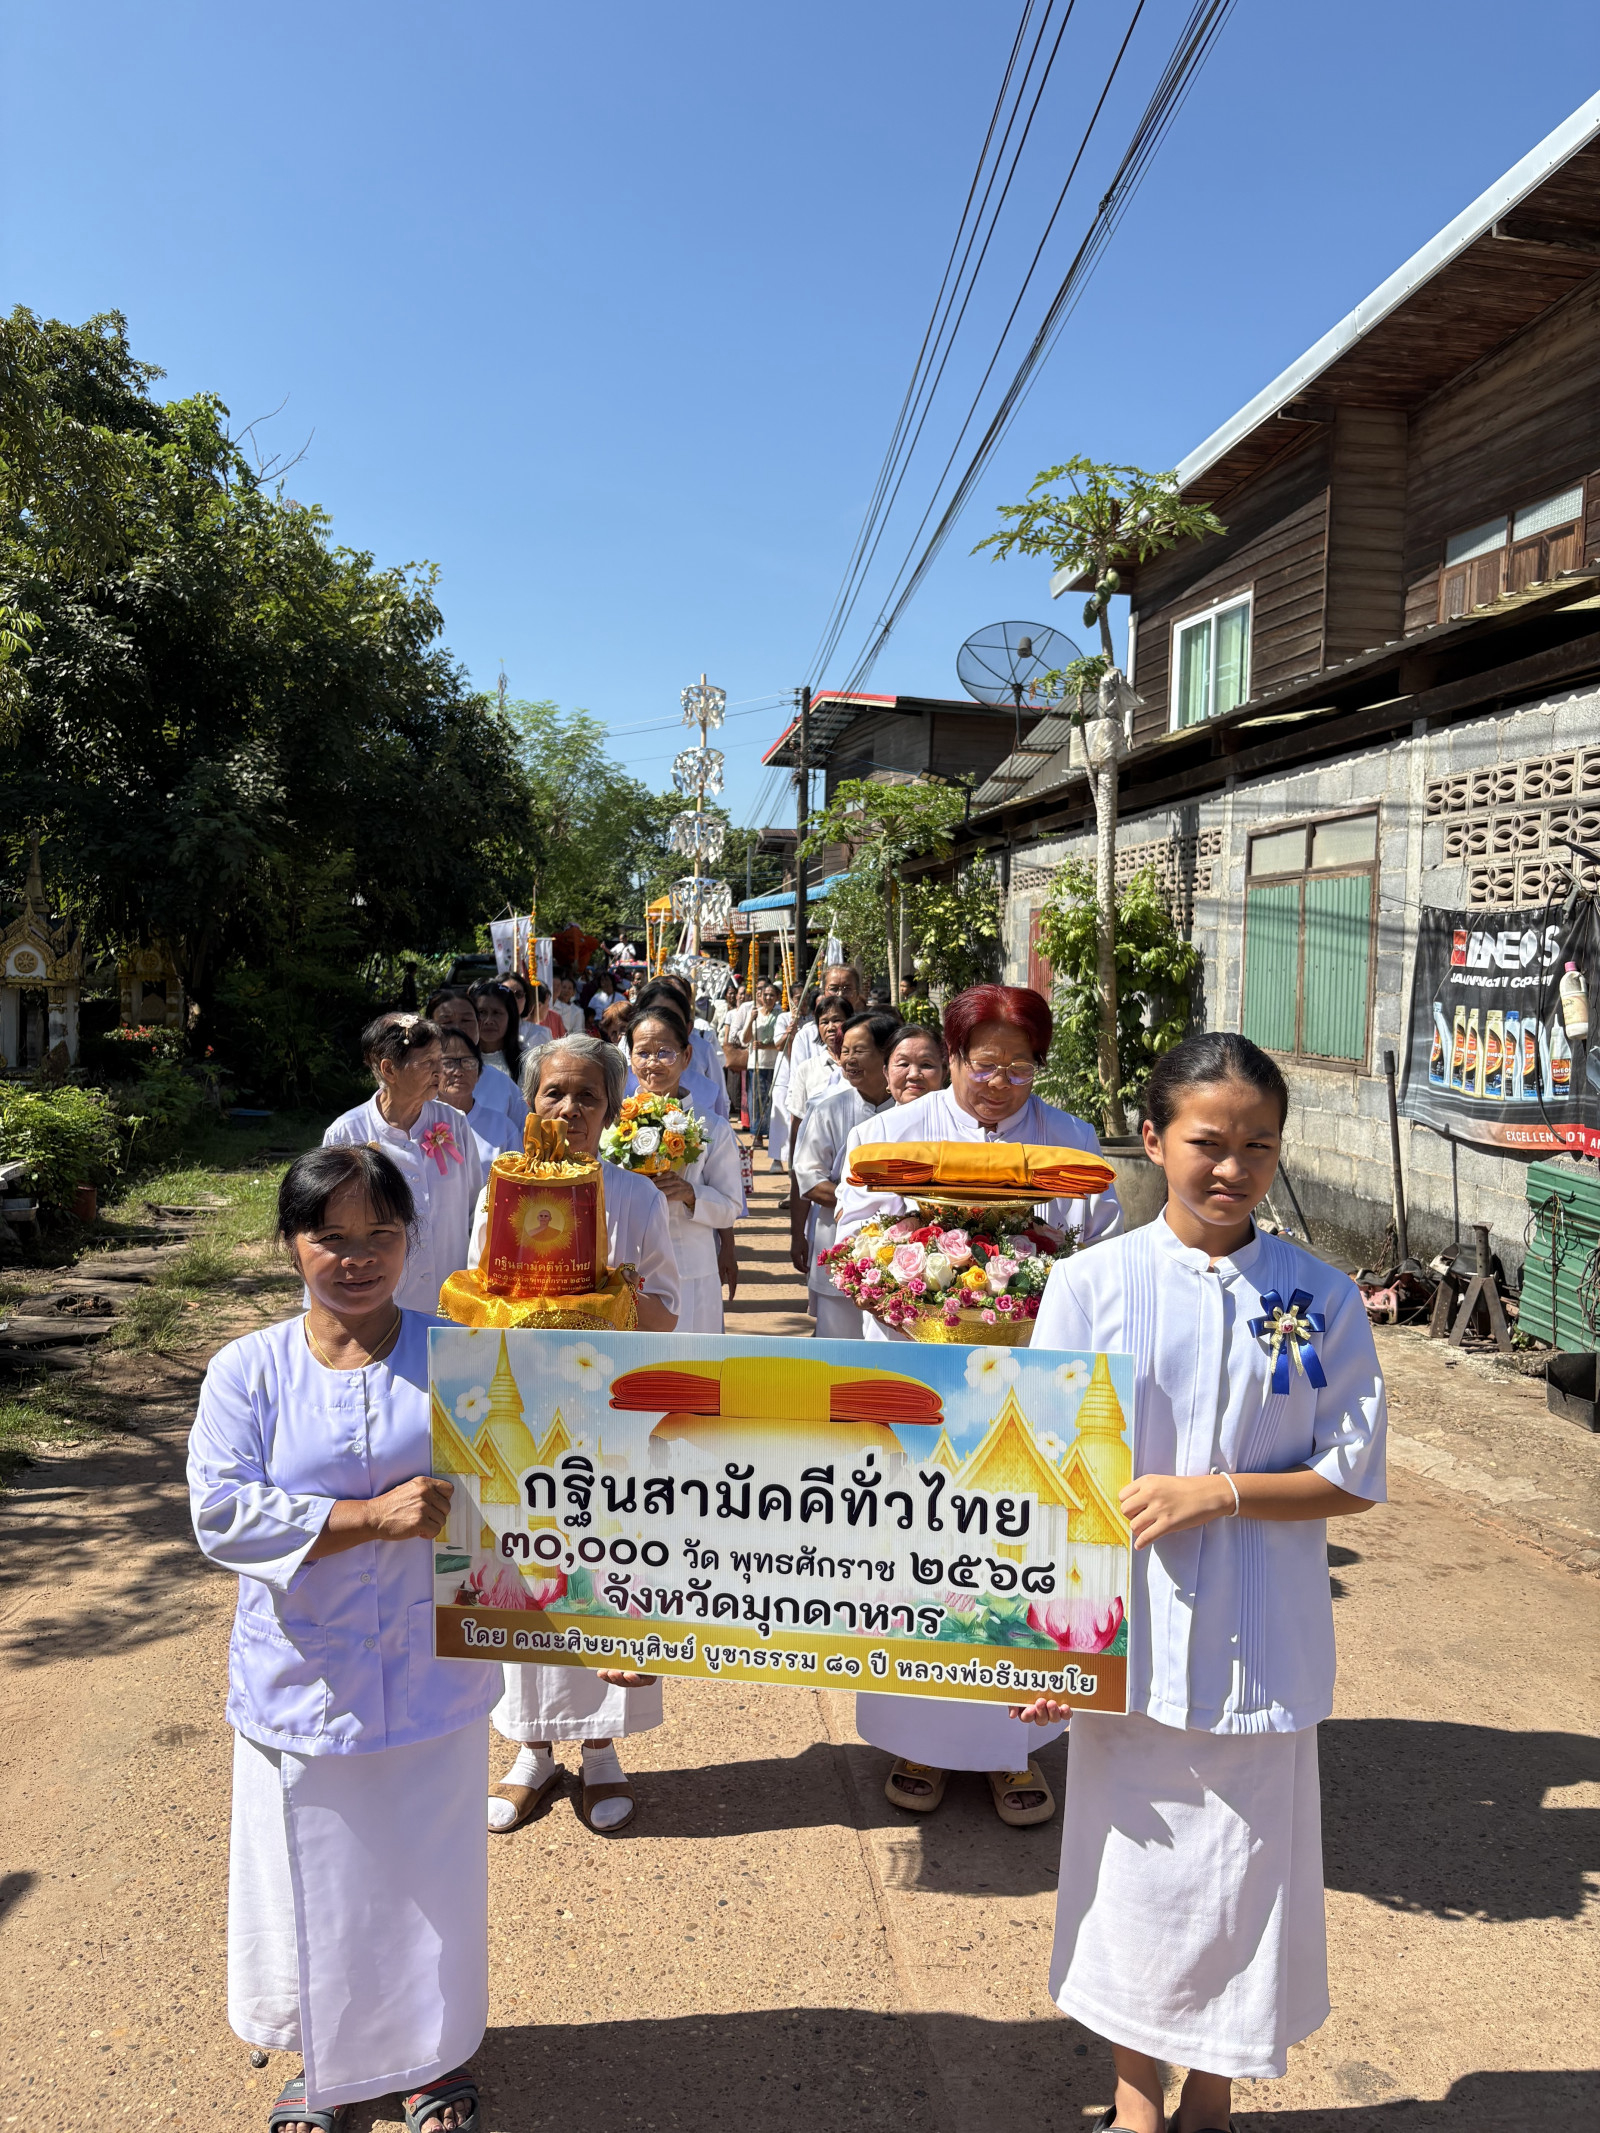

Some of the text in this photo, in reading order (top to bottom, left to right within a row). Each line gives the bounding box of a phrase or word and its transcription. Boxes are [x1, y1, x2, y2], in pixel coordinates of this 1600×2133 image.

[525, 1453, 1030, 1537] กฐินสามัคคีทั่วไทย
[501, 1532, 1055, 1594] ๓๐,๐๐๐ วัด พุทธศักราช ๒๕๖๘
[604, 1572, 944, 1636] จังหวัดมุกดาหาร
[463, 1621, 1095, 1692] โดย คณะศิษยานุศิษย์ บูชาธรรม ๘๑ ปี หลวงพ่อธัมมชโย
